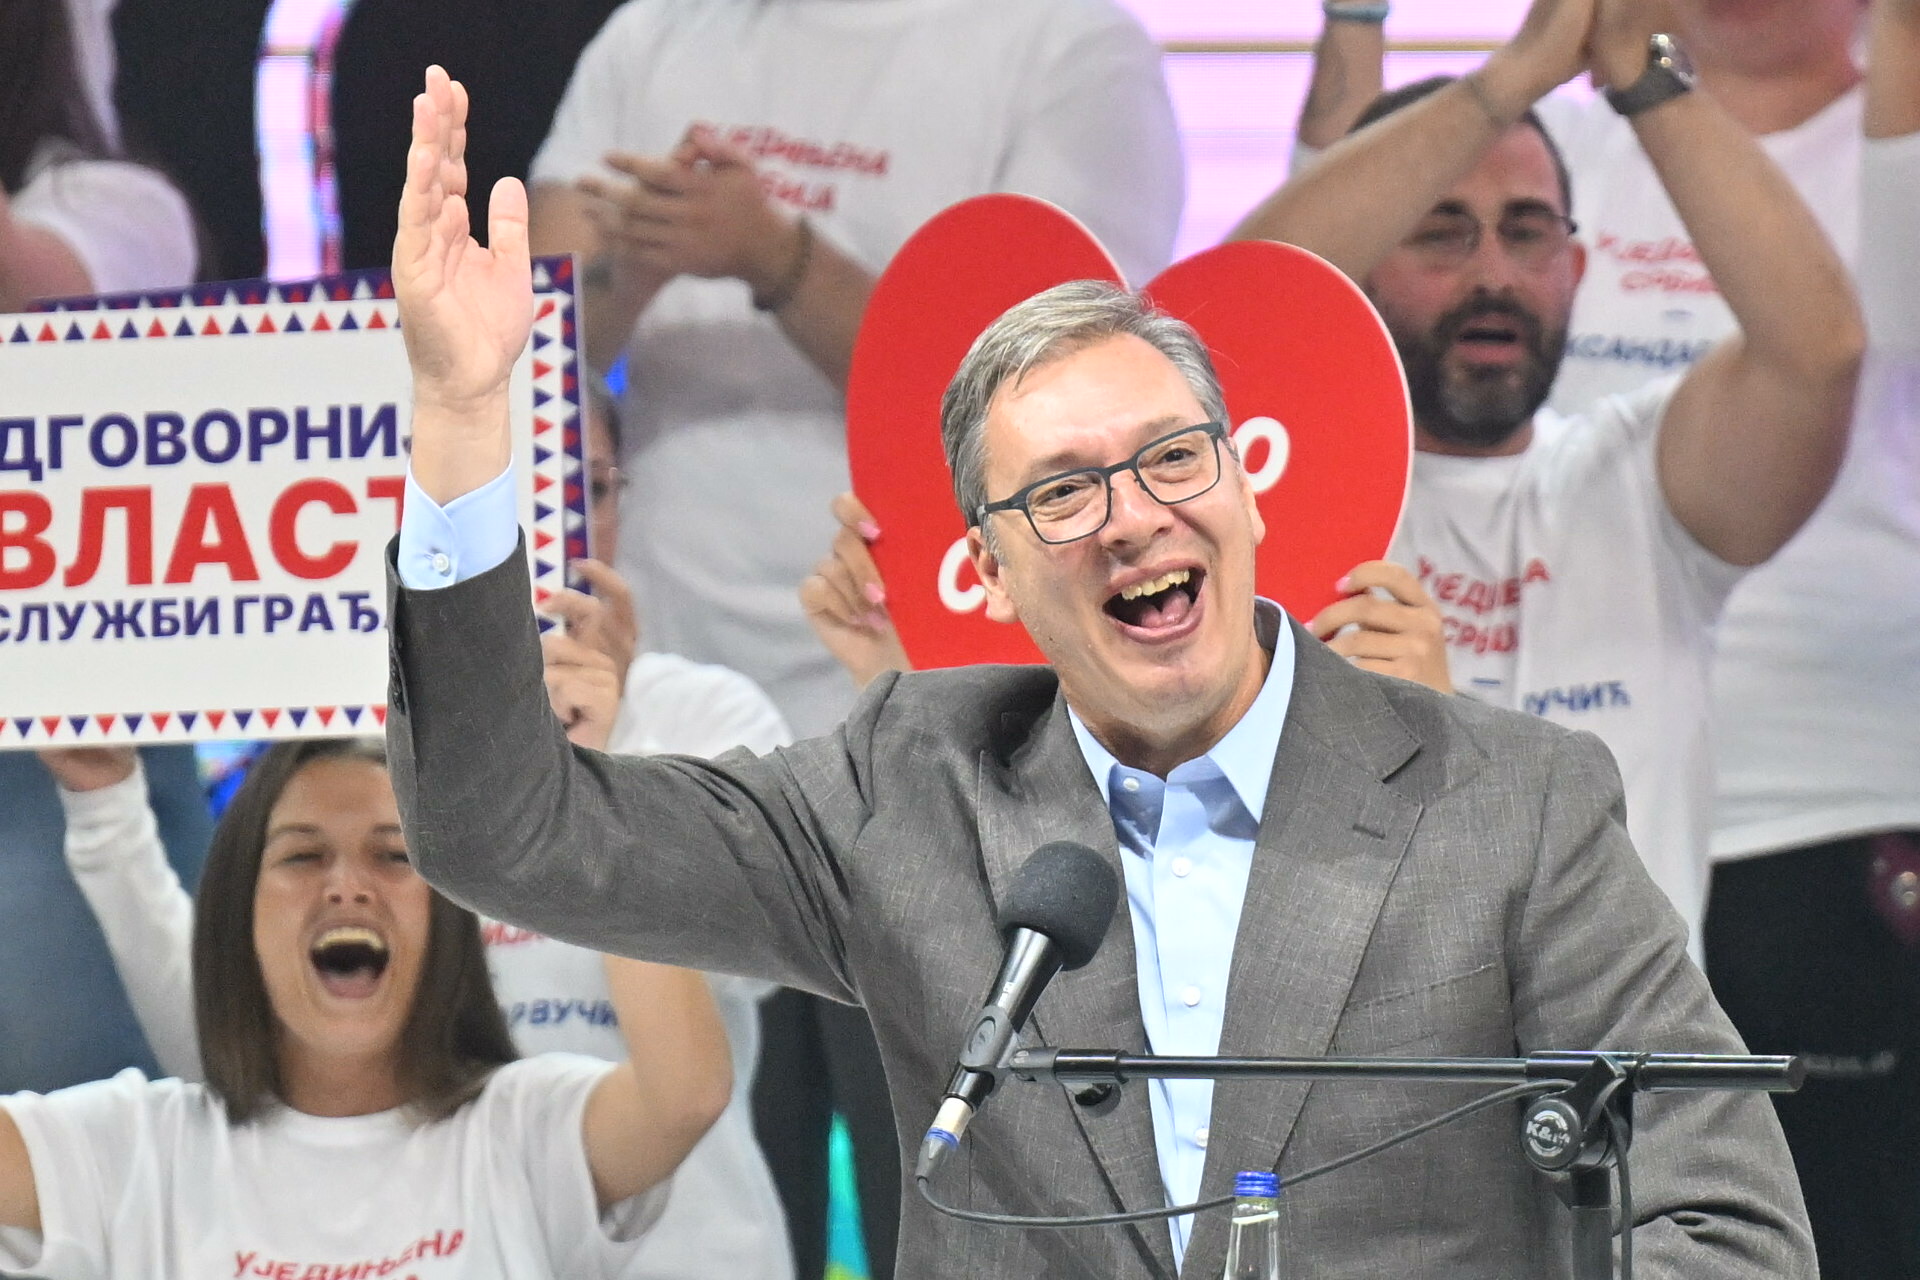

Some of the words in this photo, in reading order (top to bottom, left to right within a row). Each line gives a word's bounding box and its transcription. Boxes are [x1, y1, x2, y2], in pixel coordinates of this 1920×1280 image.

[0, 403, 413, 481] ДГОВОРНИ
[0, 598, 219, 642] ЛУЖБИ
[233, 591, 389, 633] ГРАЂ
